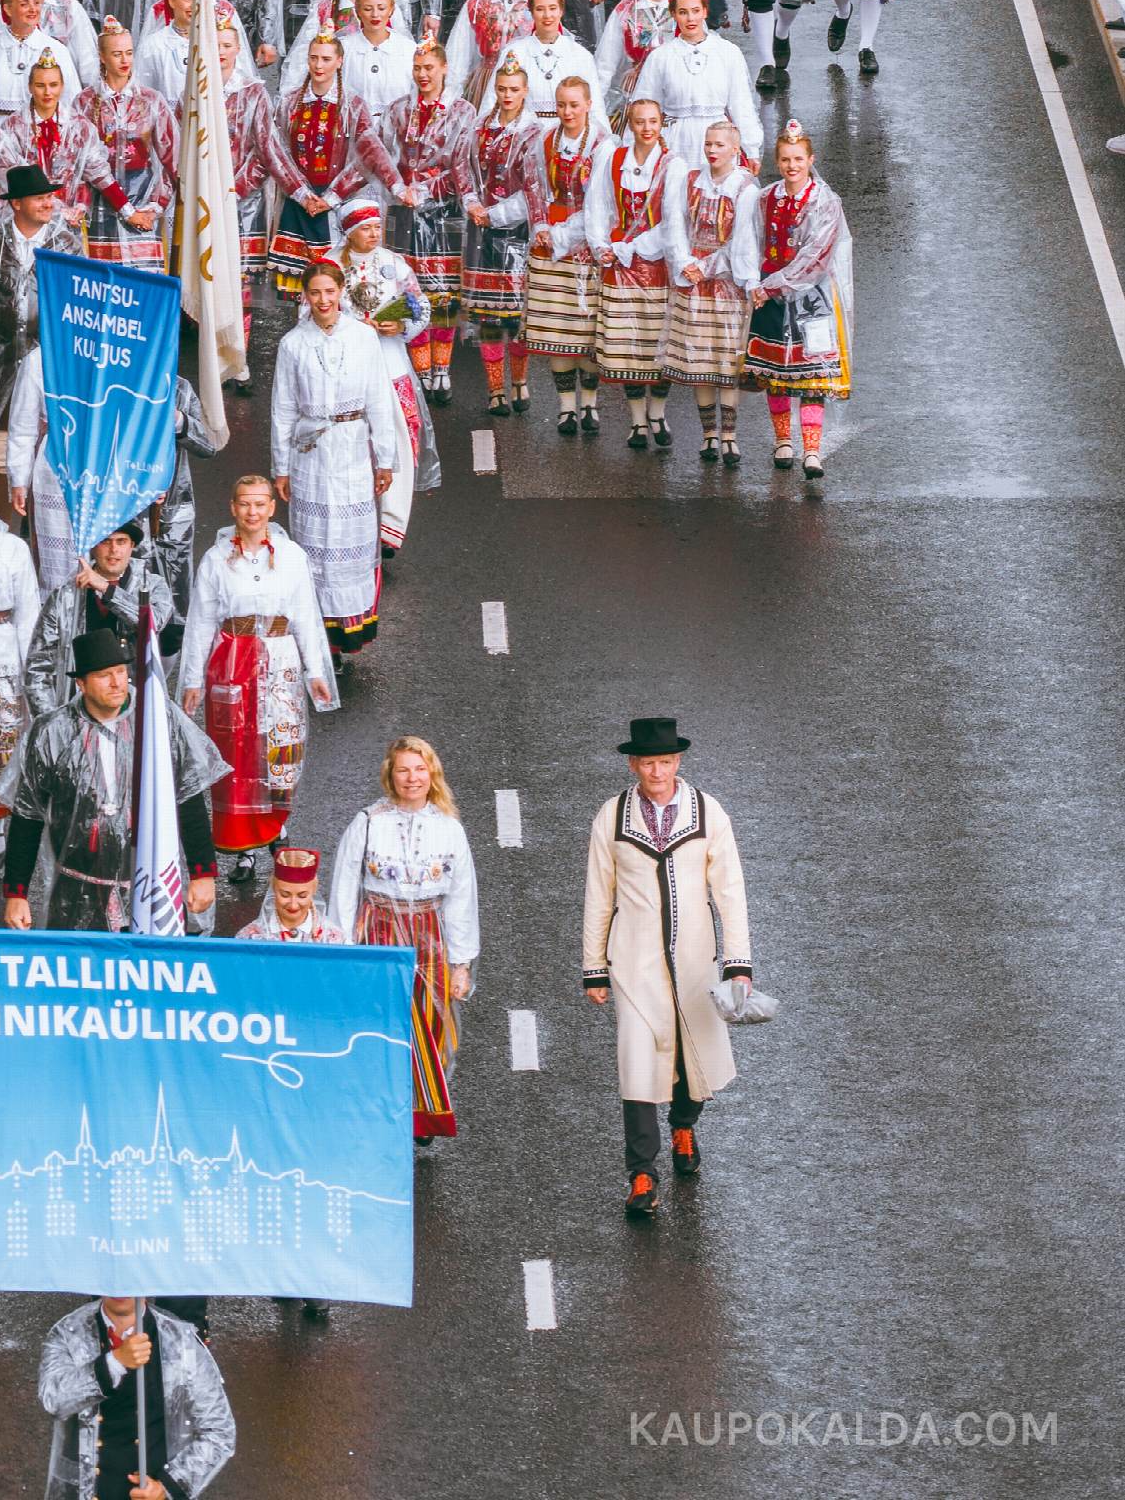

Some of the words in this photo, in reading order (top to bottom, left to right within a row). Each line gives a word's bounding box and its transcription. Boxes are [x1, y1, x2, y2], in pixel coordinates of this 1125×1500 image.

[72, 275, 140, 308] TANTSU-
[62, 302, 147, 341] ANSAMBEL
[73, 336, 131, 369] KULJUS
[0, 955, 216, 994] TALLINNA
[89, 1236, 170, 1256] TALLINN
